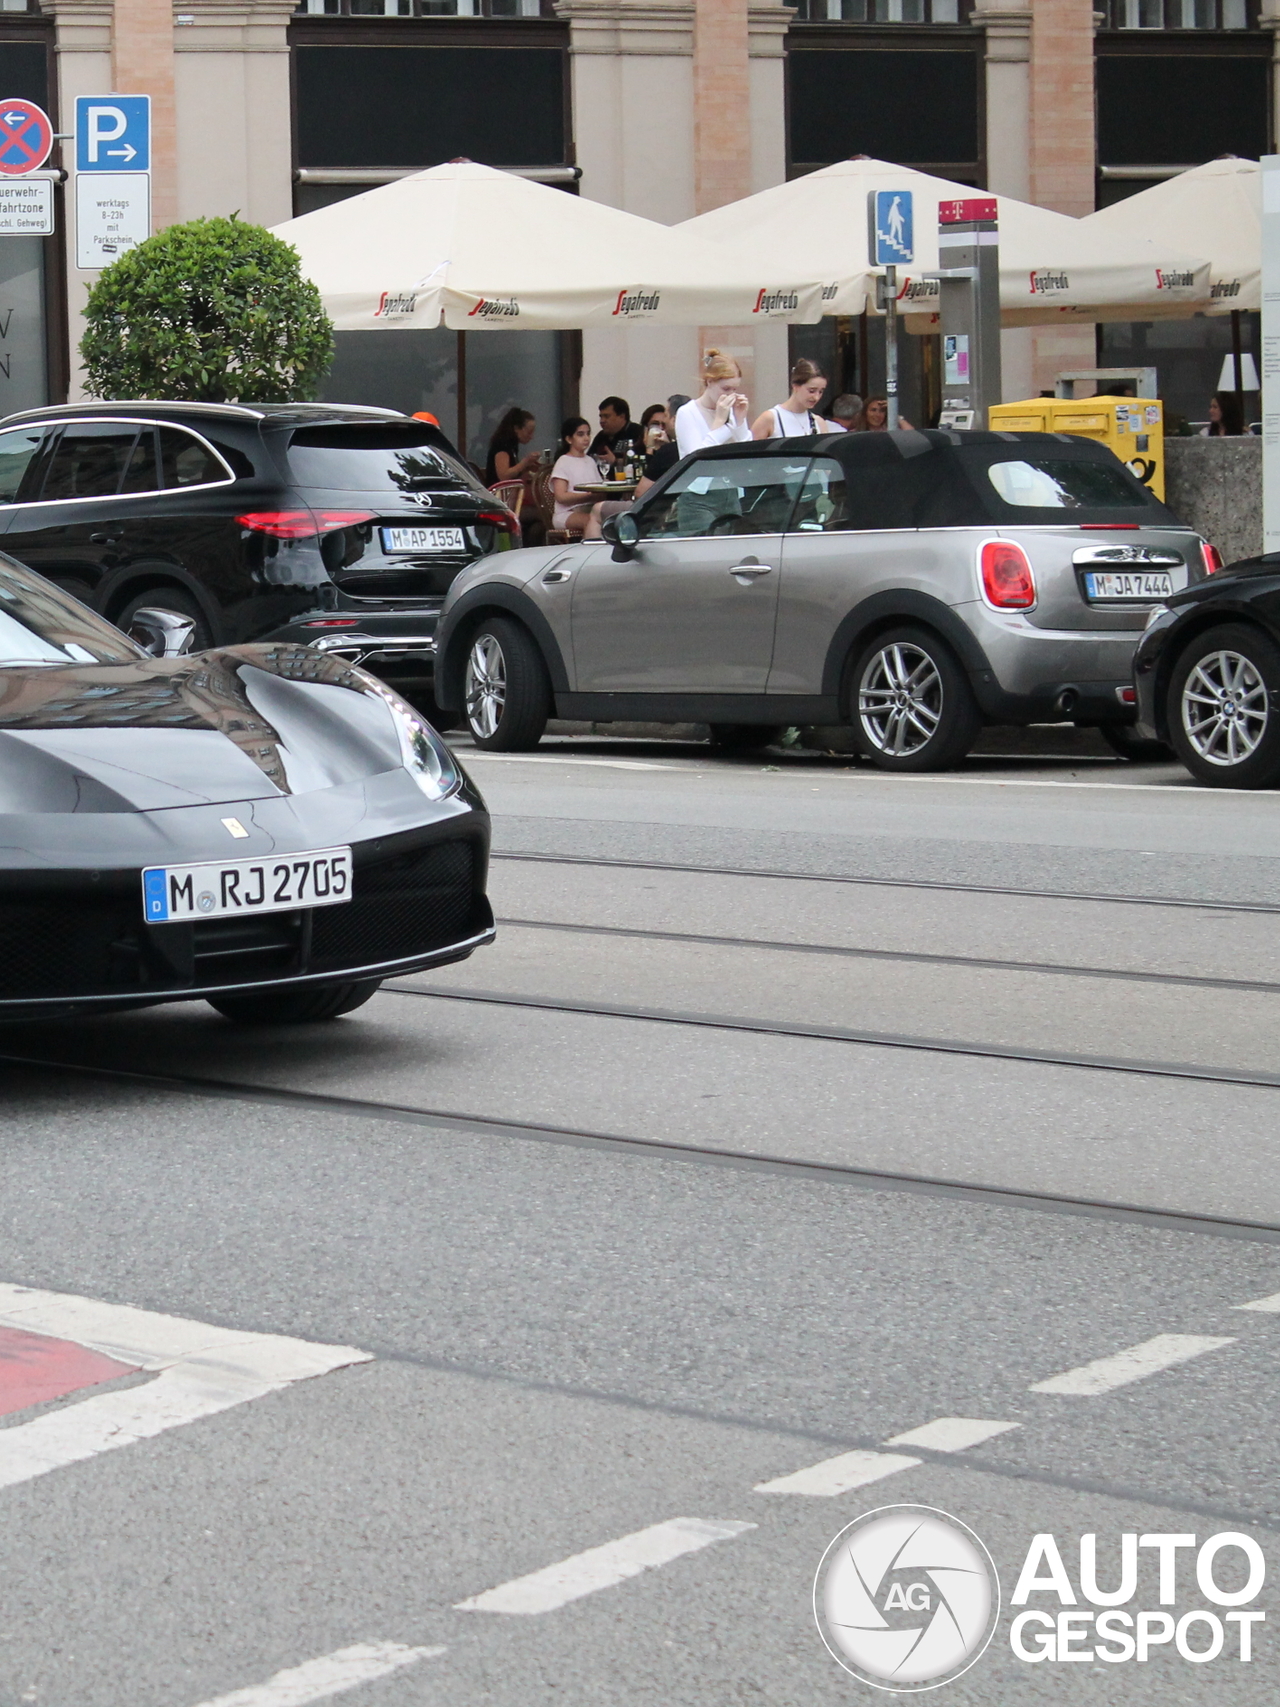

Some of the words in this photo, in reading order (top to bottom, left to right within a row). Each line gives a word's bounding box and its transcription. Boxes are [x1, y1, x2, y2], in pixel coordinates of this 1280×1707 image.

[87, 106, 128, 163] P
[96, 199, 130, 208] werktags
[16, 218, 48, 229] Gehweg)
[101, 211, 124, 220] 8-23h
[106, 223, 119, 231] mit
[93, 235, 133, 244] Parkschein
[1210, 279, 1241, 298] afredo
[373, 291, 418, 317] Segafredo
[467, 297, 520, 317] Segafredo
[612, 289, 661, 315] Segafredo
[752, 288, 799, 314] Segafredo
[392, 530, 402, 547] M
[1096, 576, 1106, 594] M
[152, 900, 162, 912] D
[170, 873, 194, 912] M
